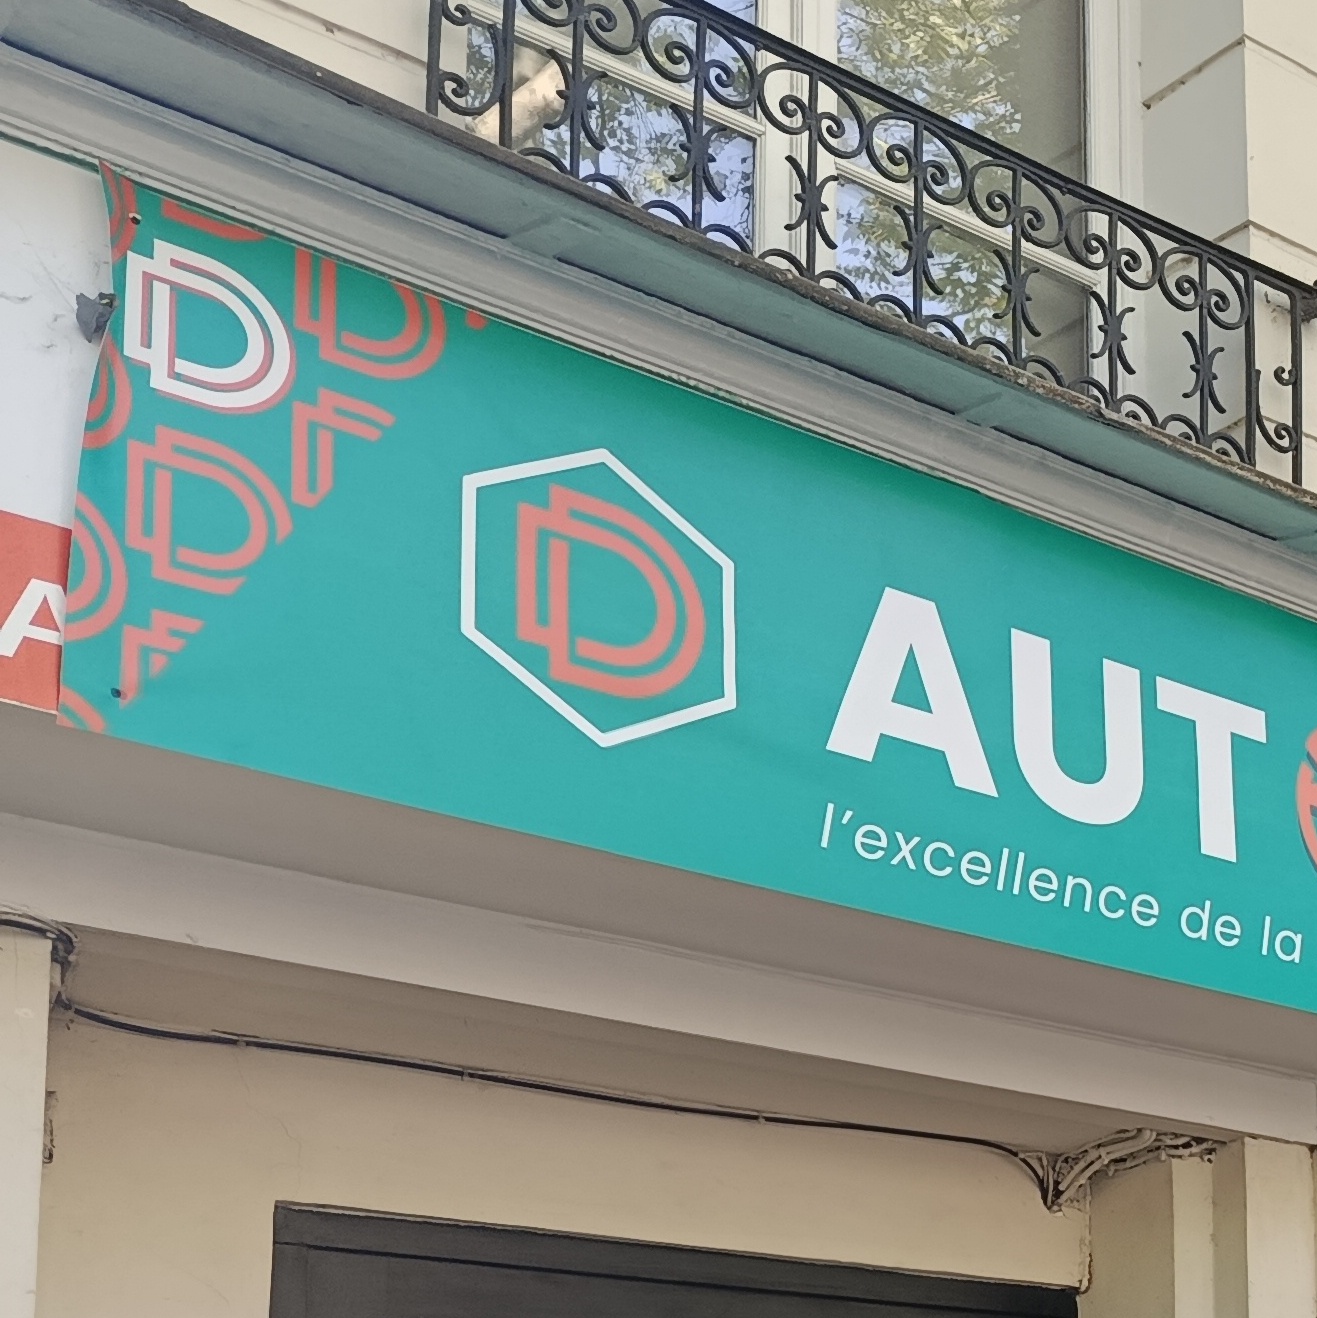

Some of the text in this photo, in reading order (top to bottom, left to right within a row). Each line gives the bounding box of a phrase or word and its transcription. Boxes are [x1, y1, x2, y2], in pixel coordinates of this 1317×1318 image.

[819, 802, 1160, 927] l'excellence
[1179, 900, 1242, 947] de
[1261, 915, 1303, 963] la
